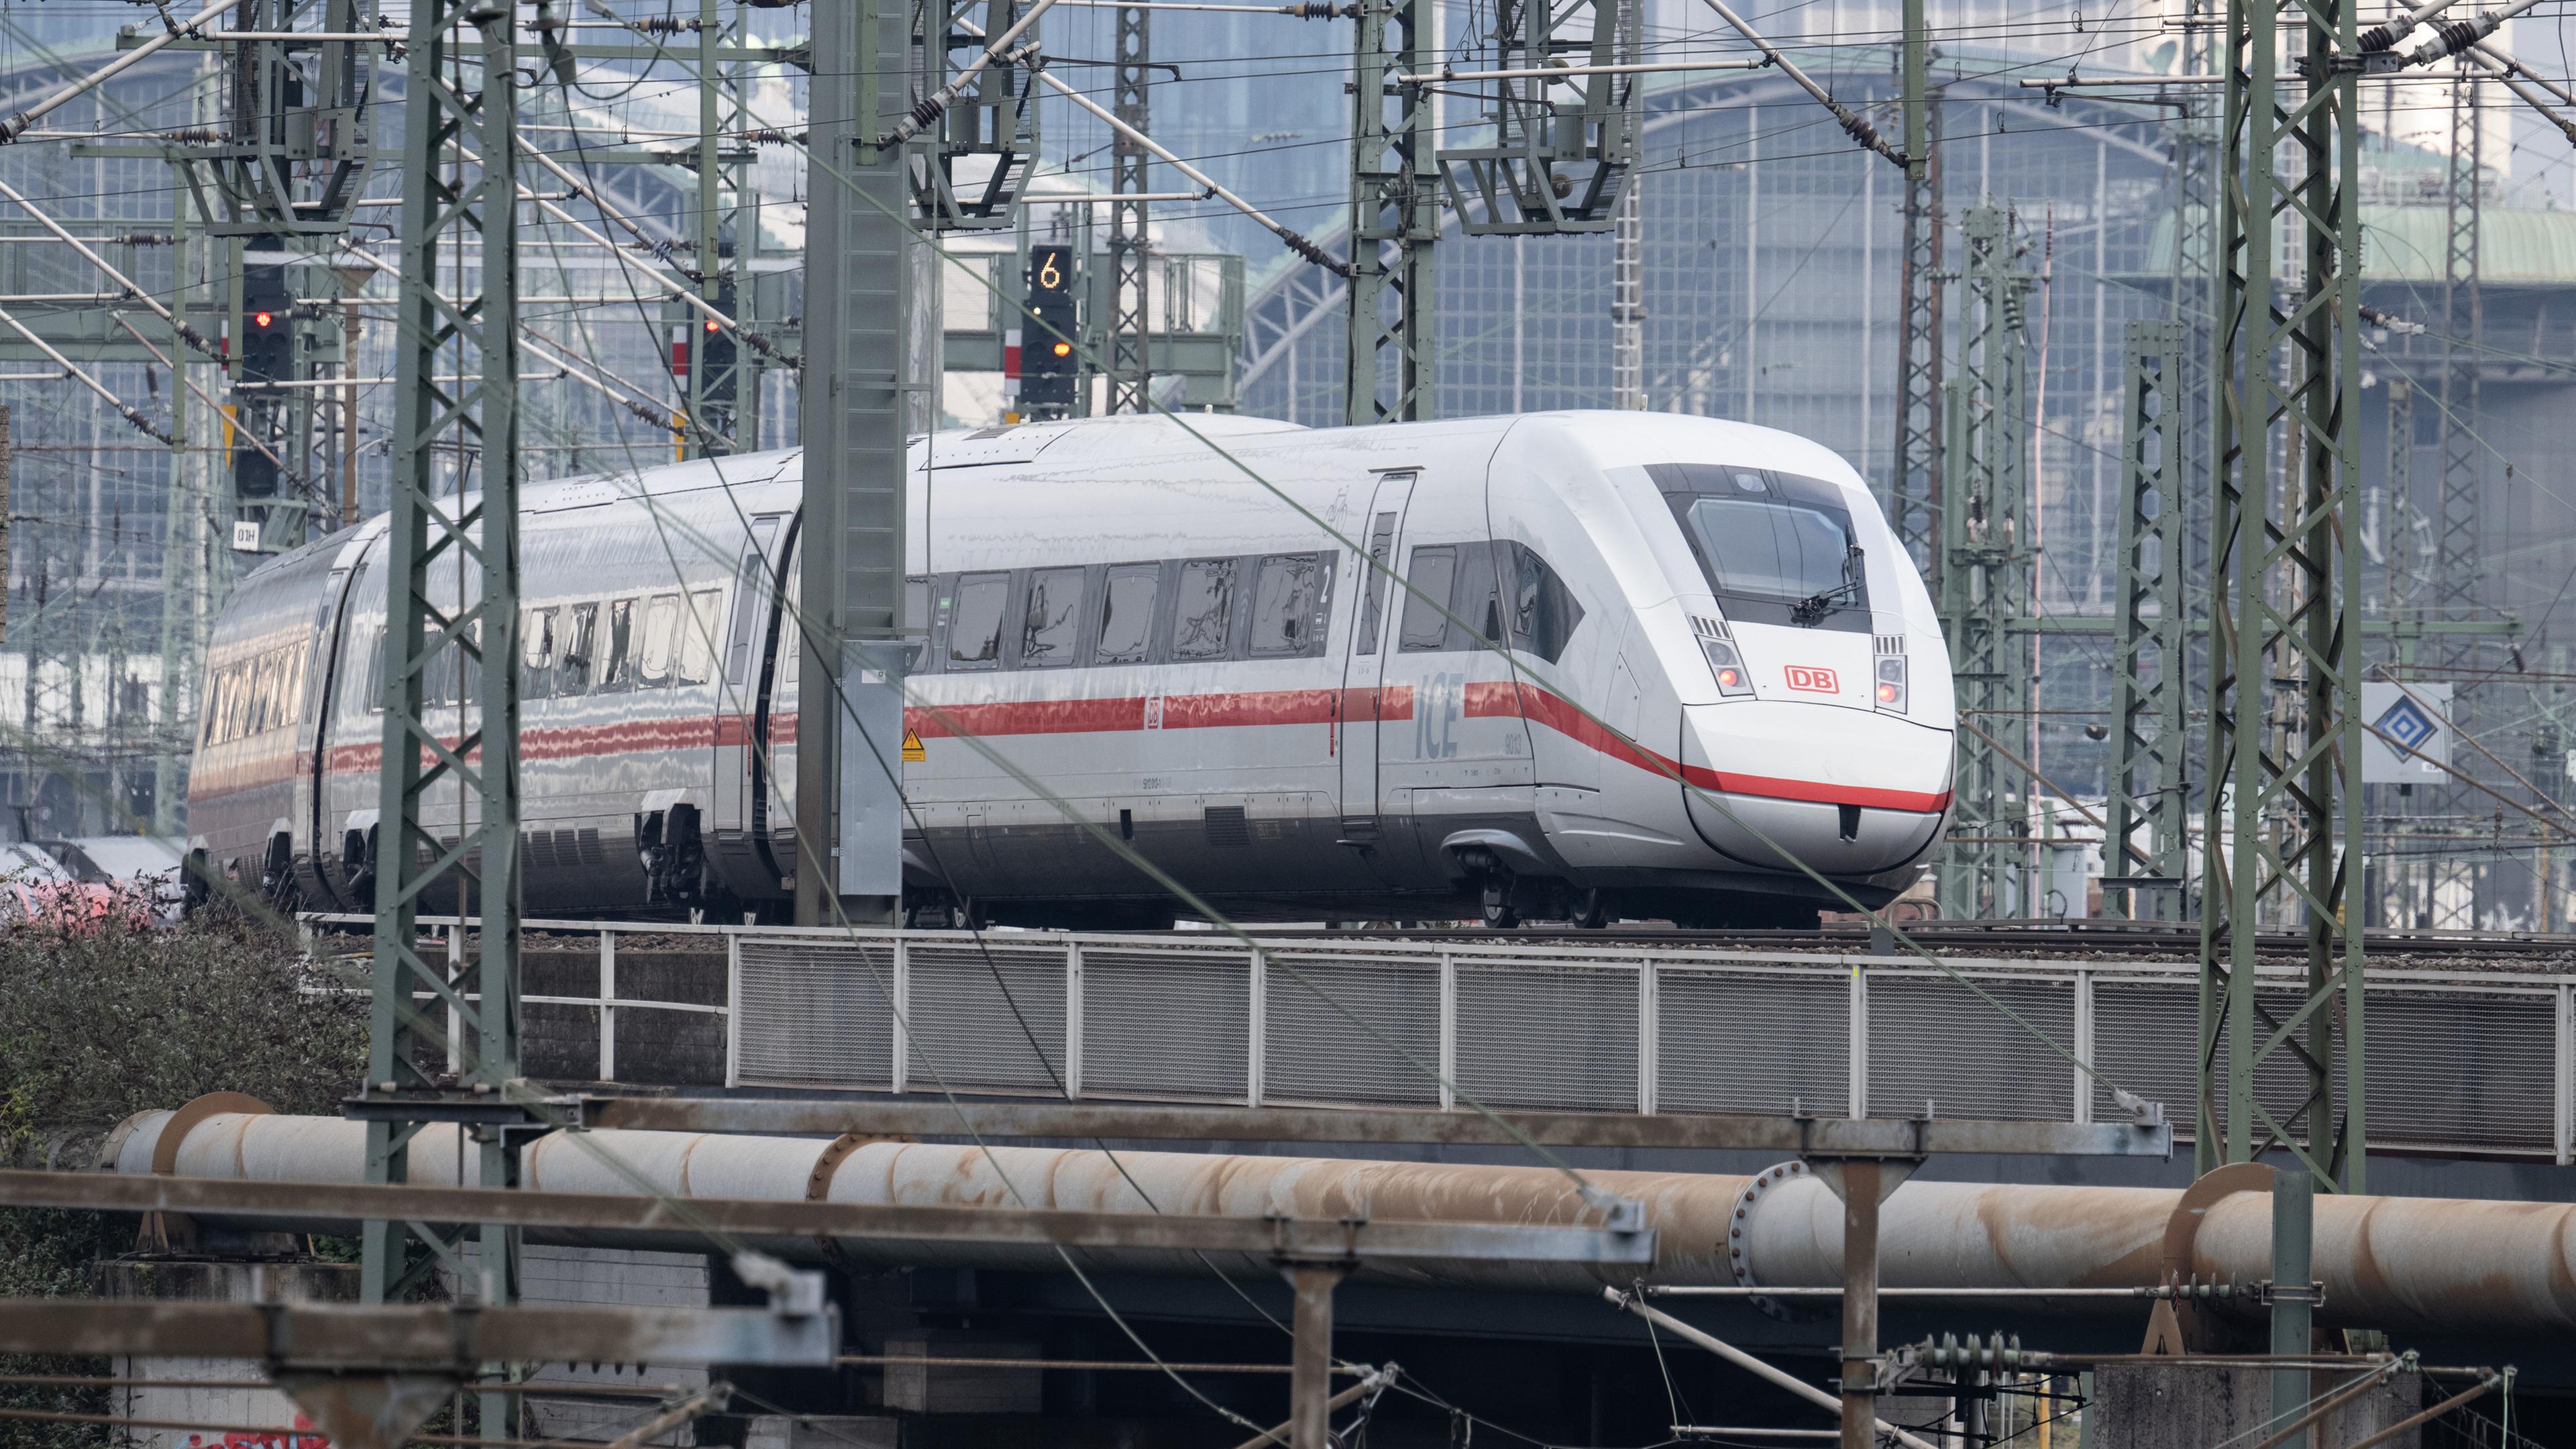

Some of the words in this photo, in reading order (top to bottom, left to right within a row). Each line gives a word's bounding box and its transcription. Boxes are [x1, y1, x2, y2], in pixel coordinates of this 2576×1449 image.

[1040, 252, 1060, 288] 6
[237, 529, 255, 542] 01H
[1320, 565, 1331, 603] 2
[1790, 669, 1833, 689] DB
[1148, 701, 1159, 724] DB
[1415, 672, 1464, 759] ICE
[1505, 733, 1521, 755] 9013
